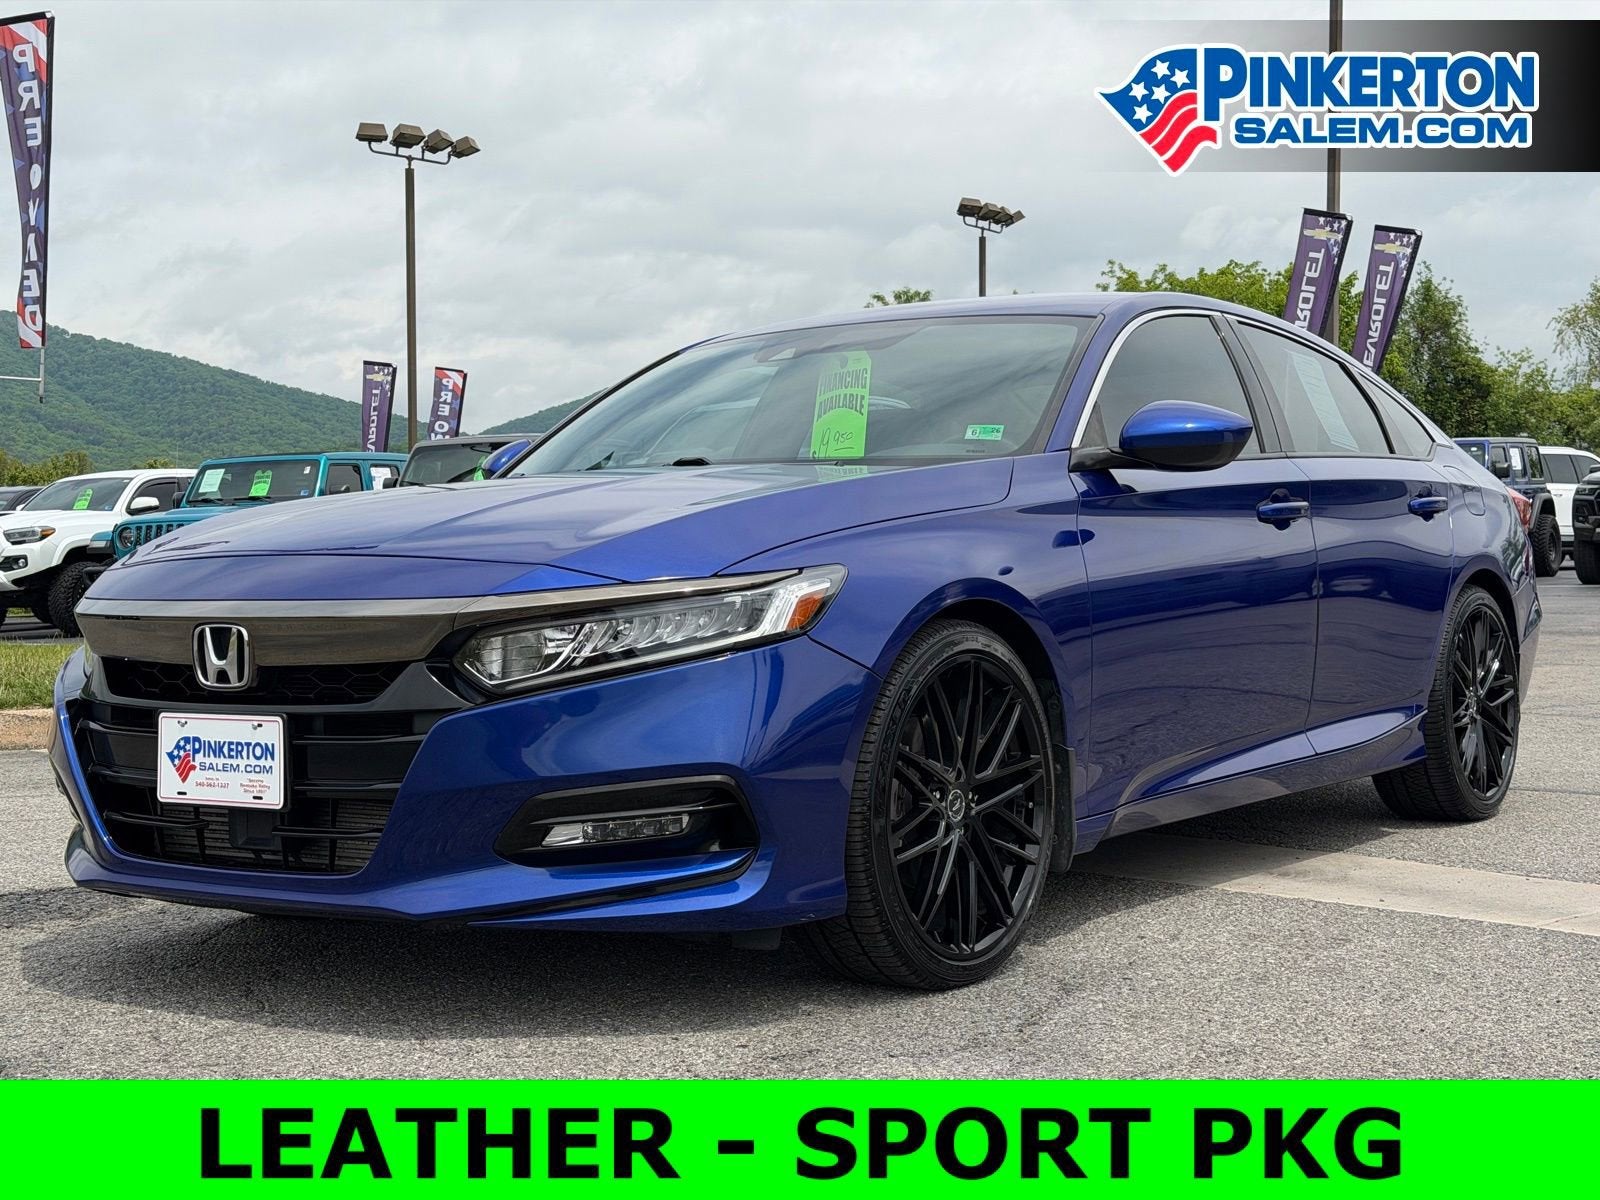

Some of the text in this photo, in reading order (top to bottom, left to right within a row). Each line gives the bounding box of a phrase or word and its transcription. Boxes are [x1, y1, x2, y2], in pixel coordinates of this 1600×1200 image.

[818, 367, 868, 397] FINANCING
[816, 393, 866, 422] AVAILABLE
[191, 735, 275, 763] PINKERTON
[198, 761, 273, 775] SALEM.COM
